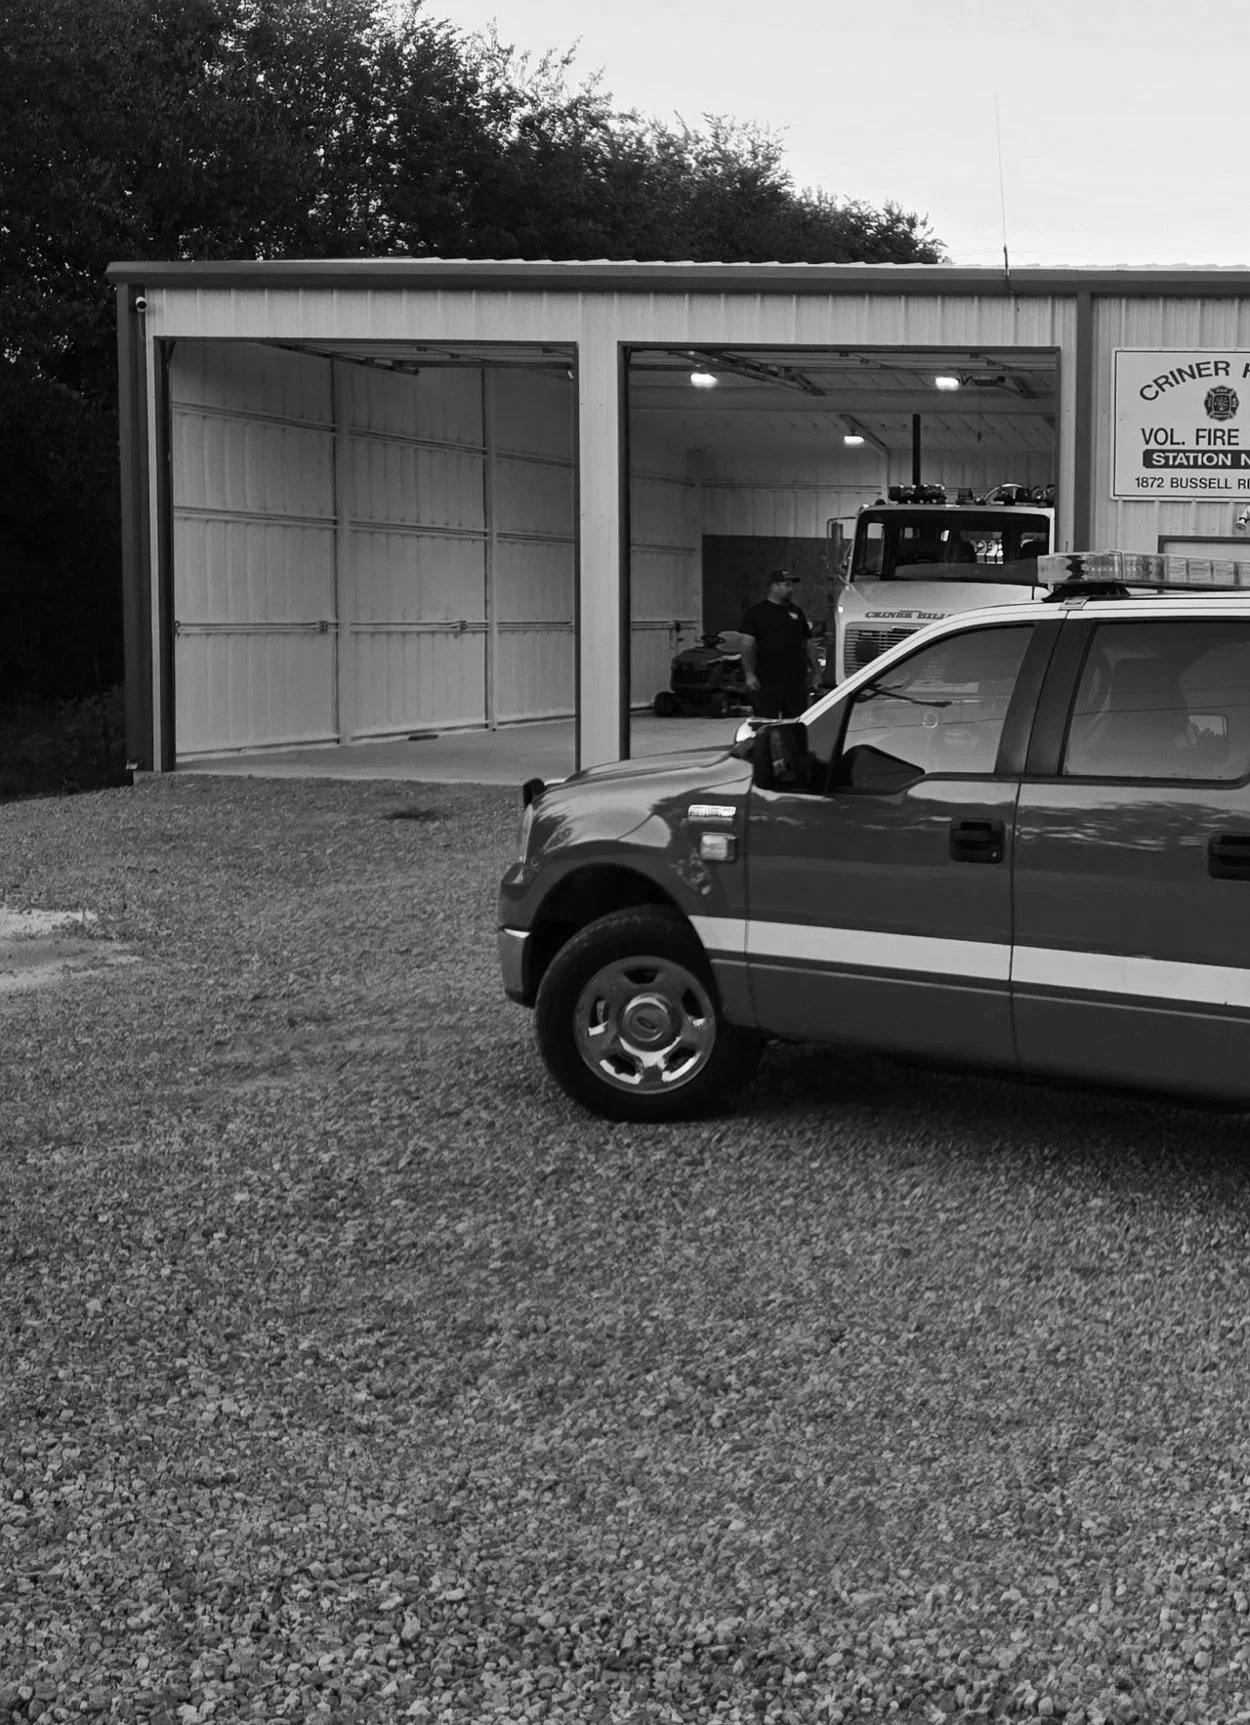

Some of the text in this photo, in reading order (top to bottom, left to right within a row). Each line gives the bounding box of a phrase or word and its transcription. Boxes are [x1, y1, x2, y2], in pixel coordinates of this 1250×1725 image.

[1139, 360, 1231, 402] CRINER
[1141, 428, 1186, 446] VOL.
[1195, 428, 1240, 447] FIRE
[1151, 452, 1232, 467] STATION
[1135, 477, 1165, 489] 1872
[1170, 477, 1233, 490] BUSSELL
